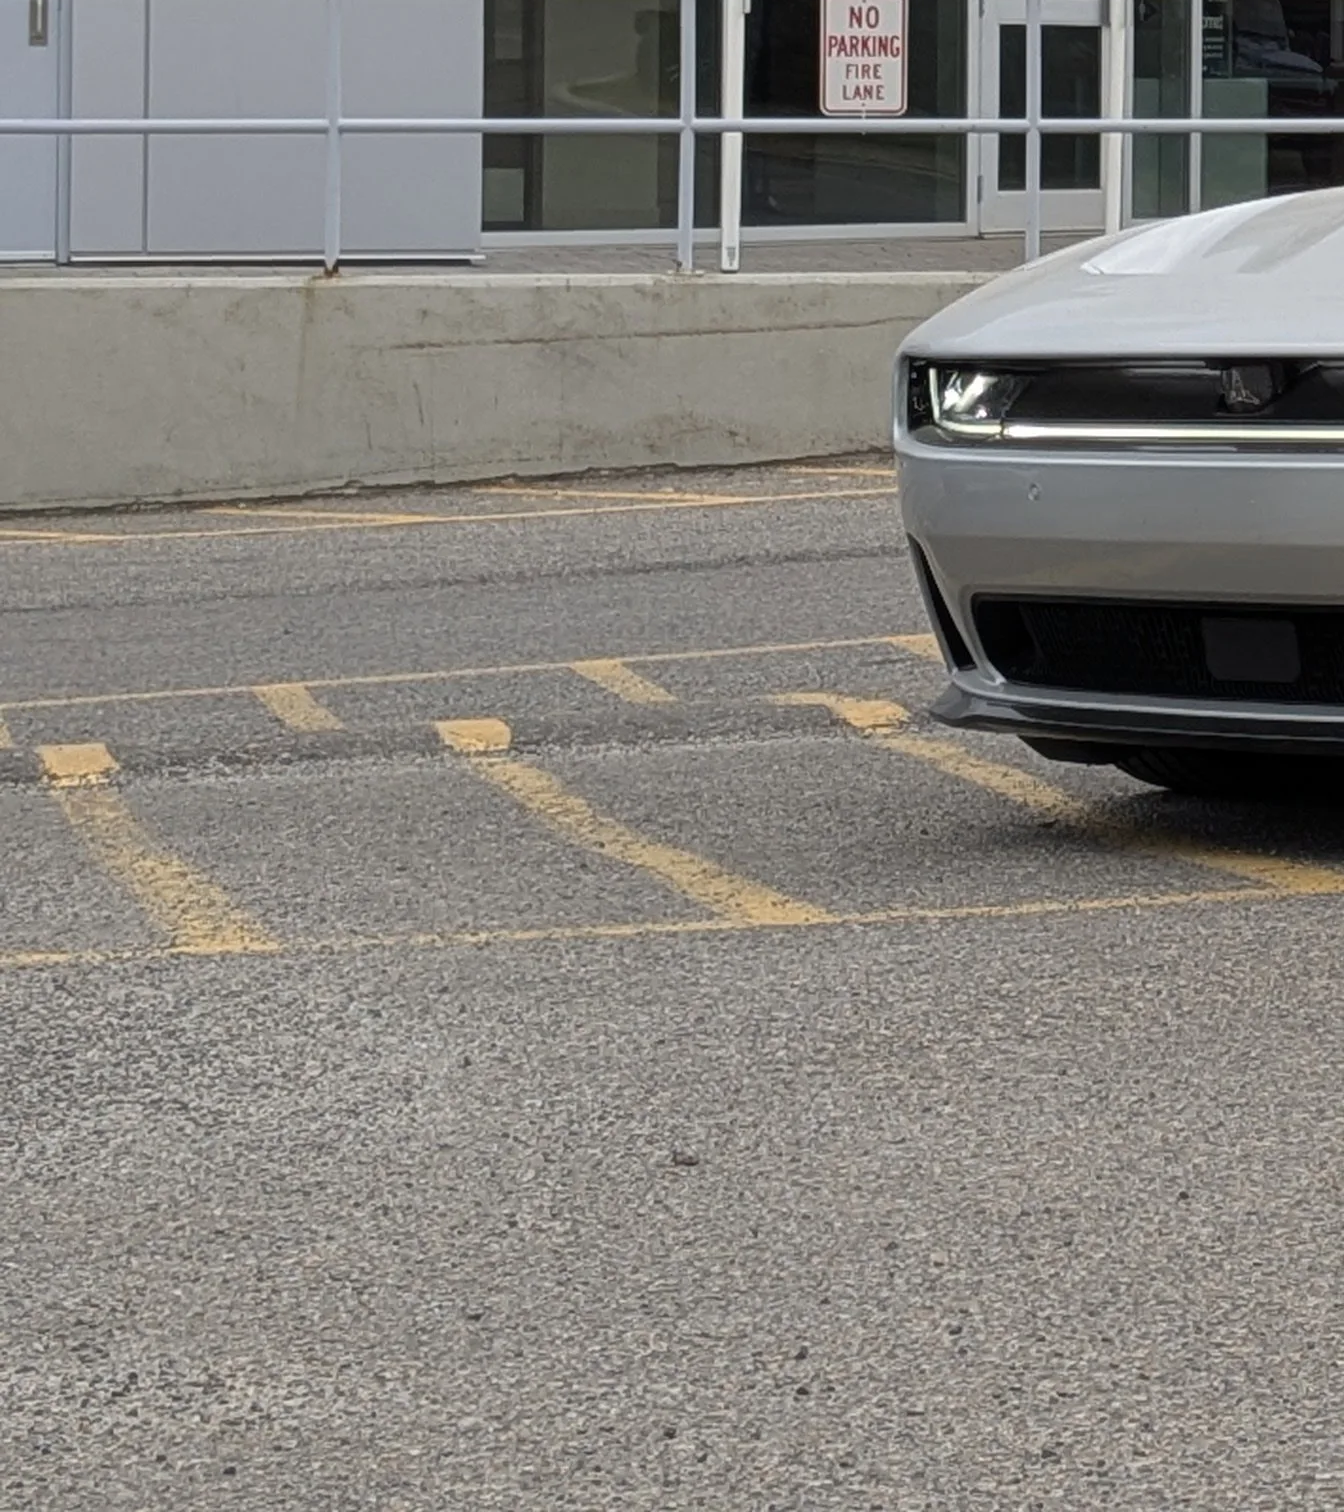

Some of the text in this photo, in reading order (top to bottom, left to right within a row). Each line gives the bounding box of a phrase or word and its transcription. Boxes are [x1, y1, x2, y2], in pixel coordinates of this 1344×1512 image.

[848, 5, 880, 29] NO
[827, 35, 901, 58] PARKING
[845, 63, 882, 80] FIRE
[842, 84, 886, 101] LANE
